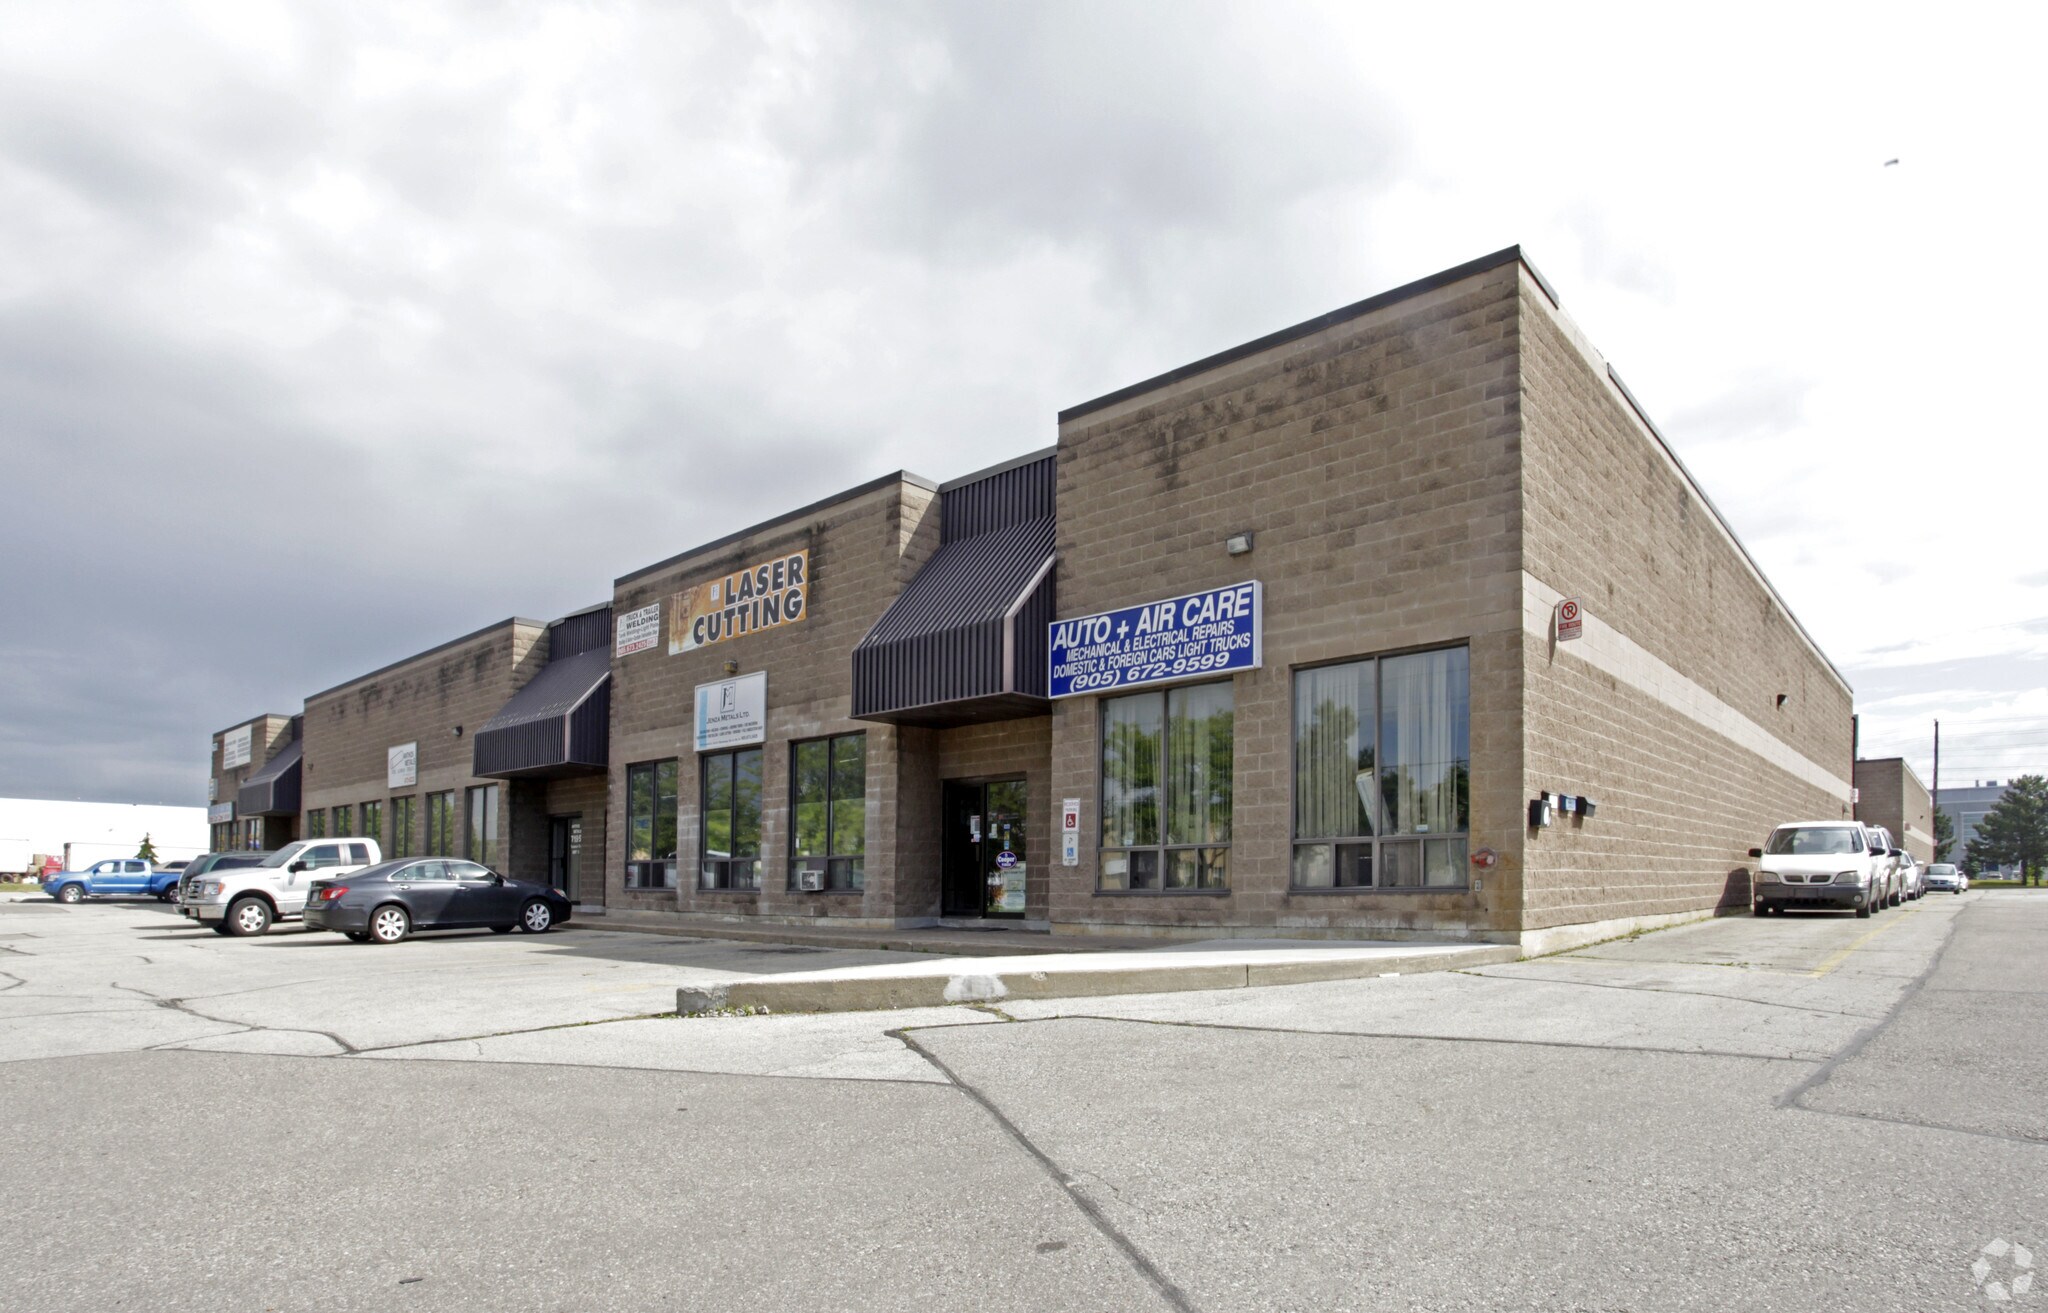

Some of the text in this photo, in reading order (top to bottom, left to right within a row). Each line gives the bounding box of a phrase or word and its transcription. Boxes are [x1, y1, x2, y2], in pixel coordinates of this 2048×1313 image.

[724, 554, 804, 607] LASER
[626, 612, 638, 621] TRUCK
[643, 604, 659, 616] TRAILER
[626, 613, 659, 630] WELDING
[693, 588, 803, 645] CUTTING
[1052, 586, 1253, 651] AUTO + AIR CARE
[1053, 632, 1251, 678] DOMESTIC & FOREIGN CARS LIGHT TRUCKS
[1066, 619, 1235, 662] MECHANICAL & ELECTRICAL REPAIRS
[1069, 652, 1230, 692] (905) 672-9599
[721, 713, 739, 722] METALS
